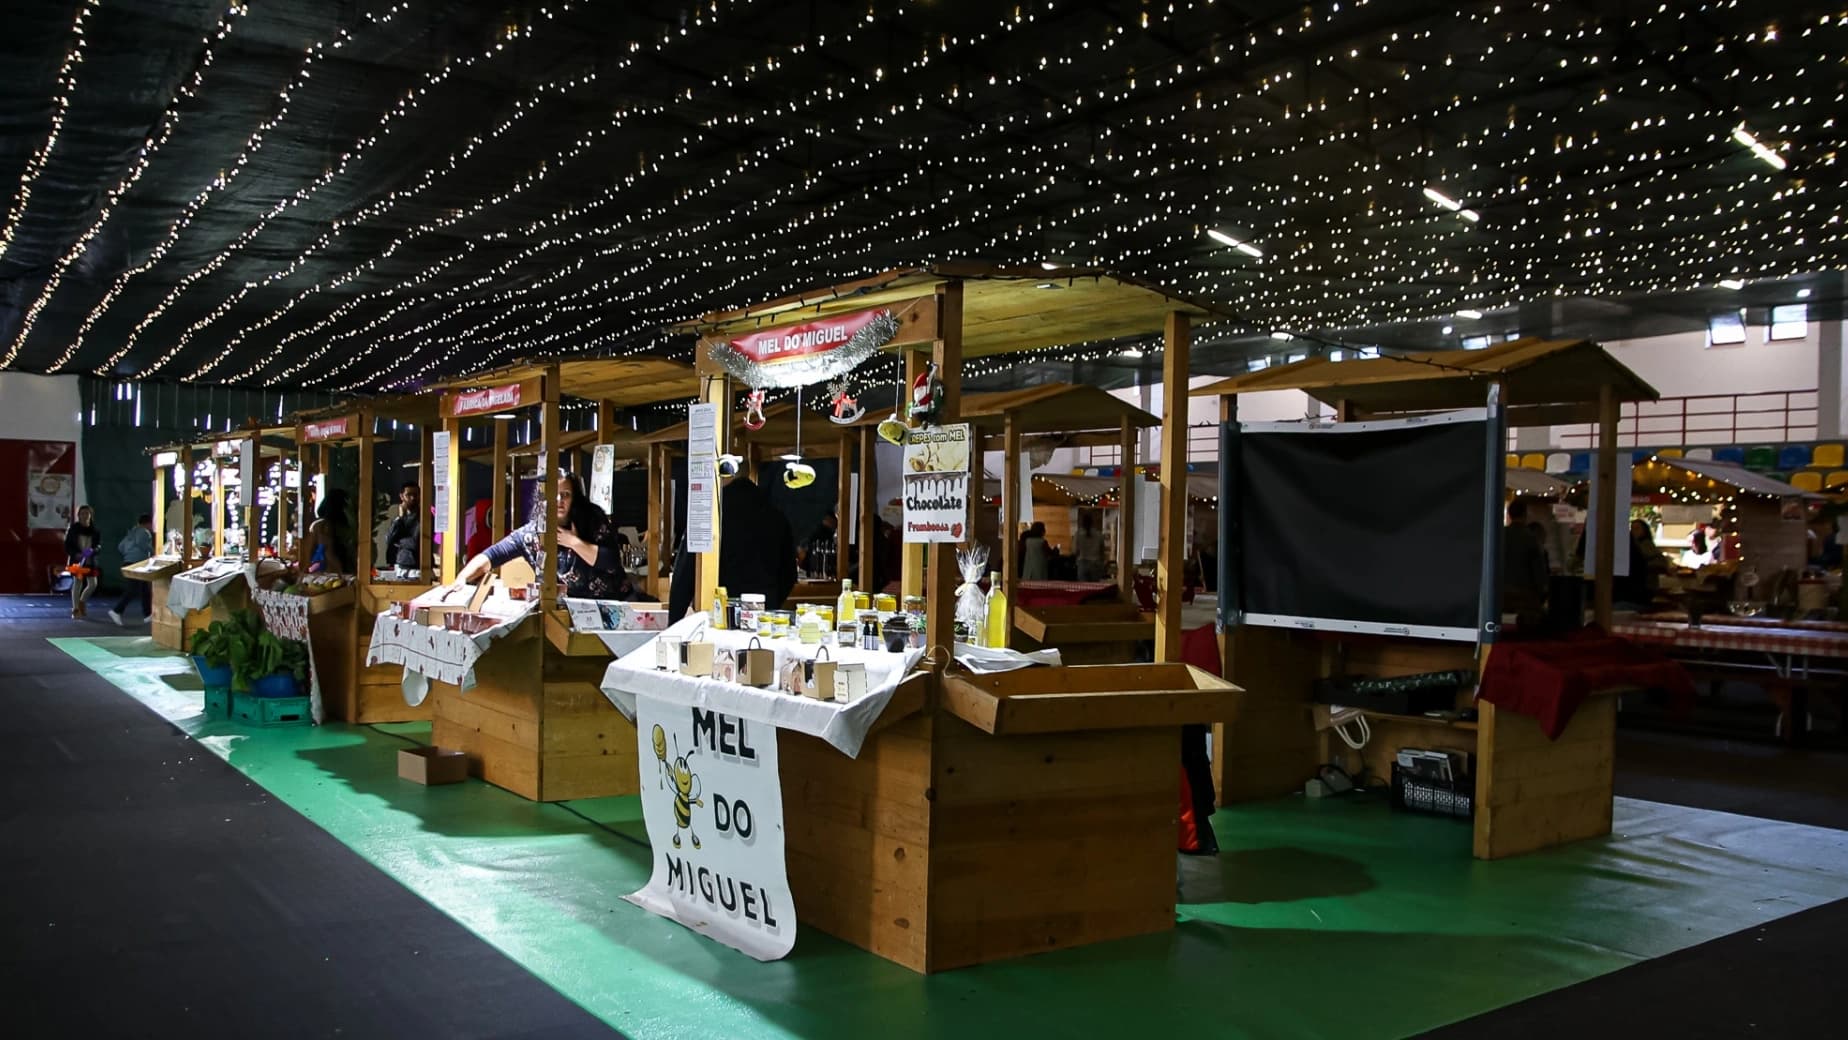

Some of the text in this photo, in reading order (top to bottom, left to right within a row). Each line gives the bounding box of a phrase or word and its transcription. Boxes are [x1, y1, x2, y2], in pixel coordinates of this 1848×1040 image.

[758, 325, 848, 355] MEL DO MIGUEL
[949, 429, 965, 441] MEL
[906, 496, 963, 511] Chocolate
[692, 706, 756, 759] MEL
[713, 793, 752, 839] DO
[666, 852, 777, 928] MIGUEL
